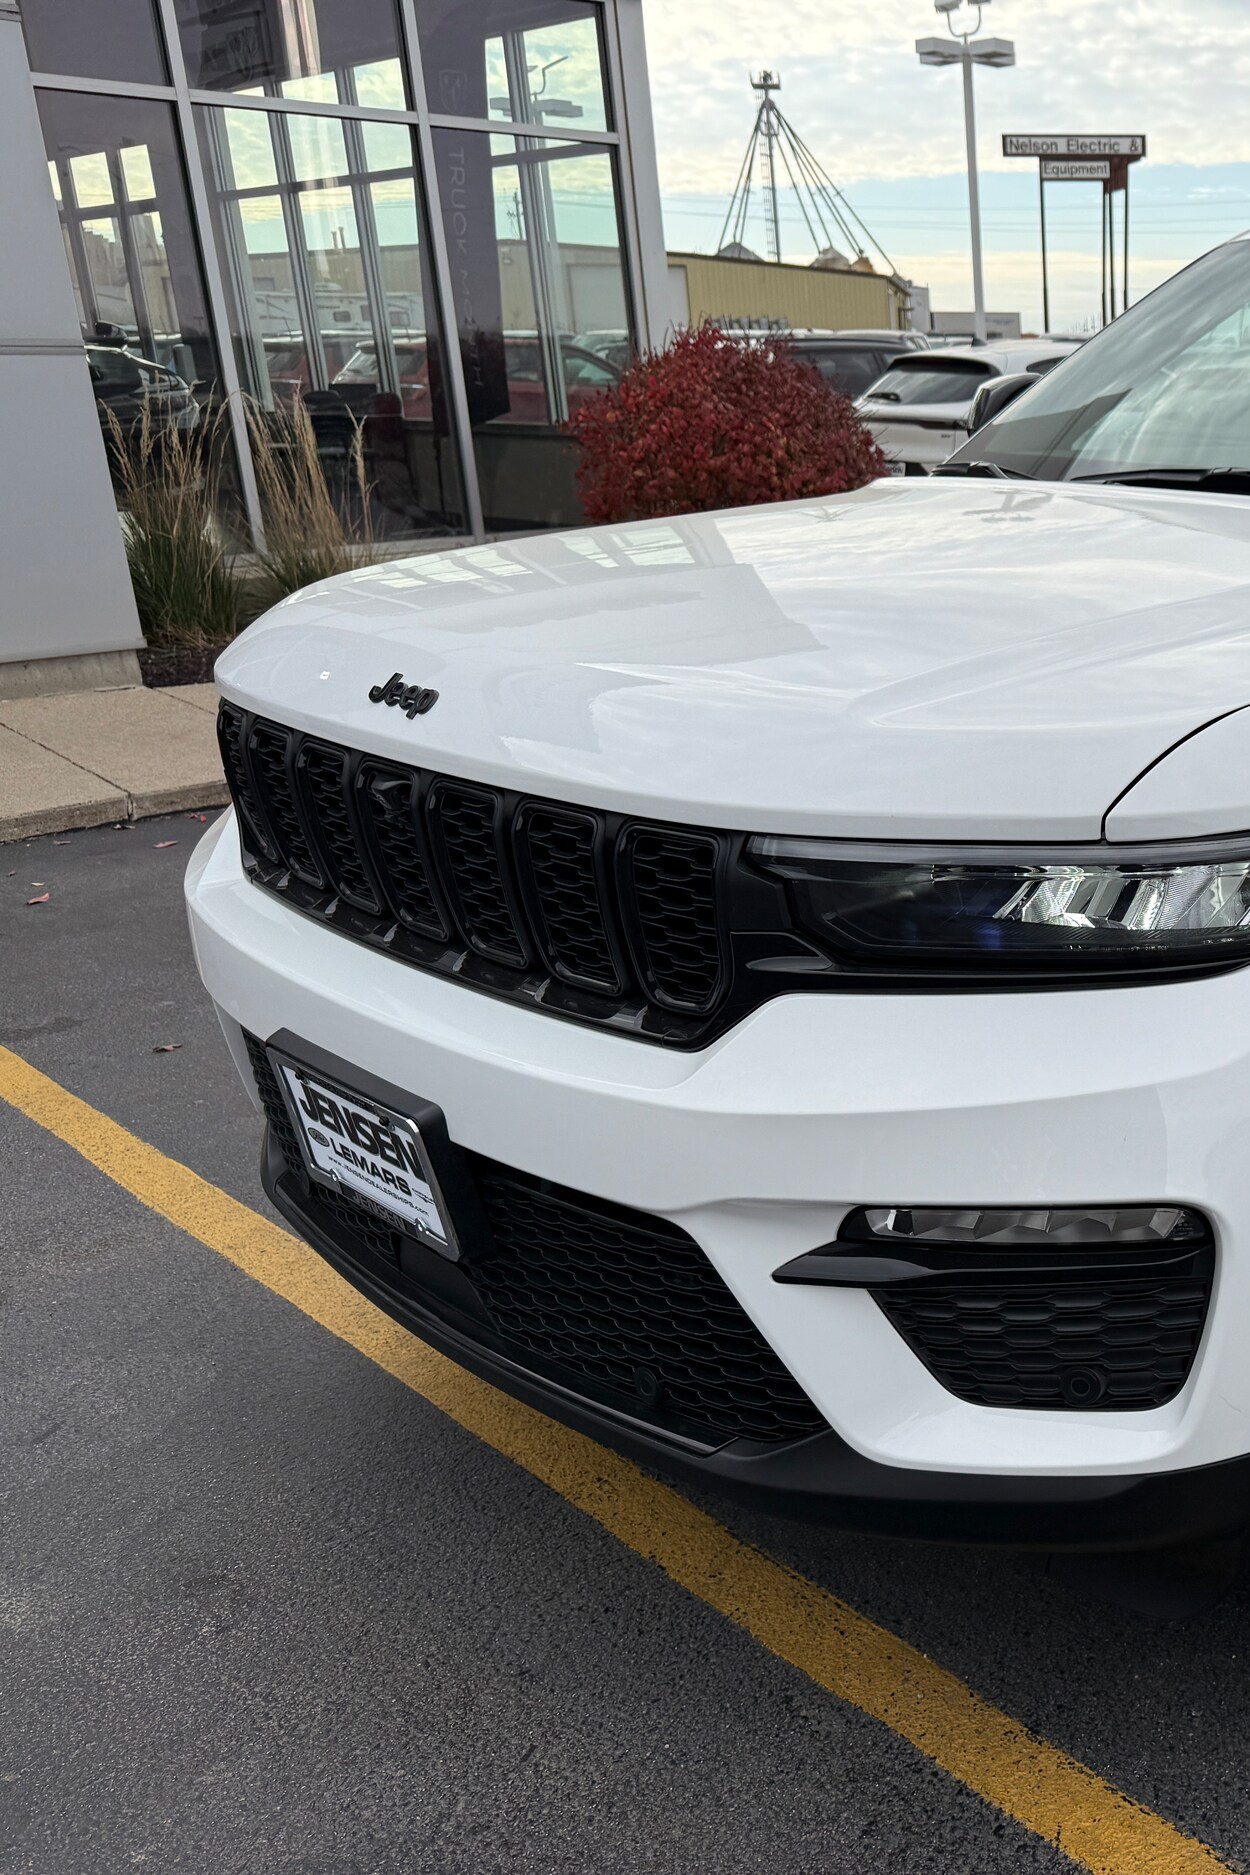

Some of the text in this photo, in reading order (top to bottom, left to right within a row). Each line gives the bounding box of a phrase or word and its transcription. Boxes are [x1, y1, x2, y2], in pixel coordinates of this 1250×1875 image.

[1009, 138, 1140, 152] Nelson Electric &
[1043, 163, 1108, 176] Equipment
[448, 147, 467, 255] TRUCK
[368, 672, 440, 720] Jeep
[298, 1083, 427, 1184] JENSEN
[329, 1137, 413, 1197] LEMARS
[352, 1191, 405, 1229] JENSEN
